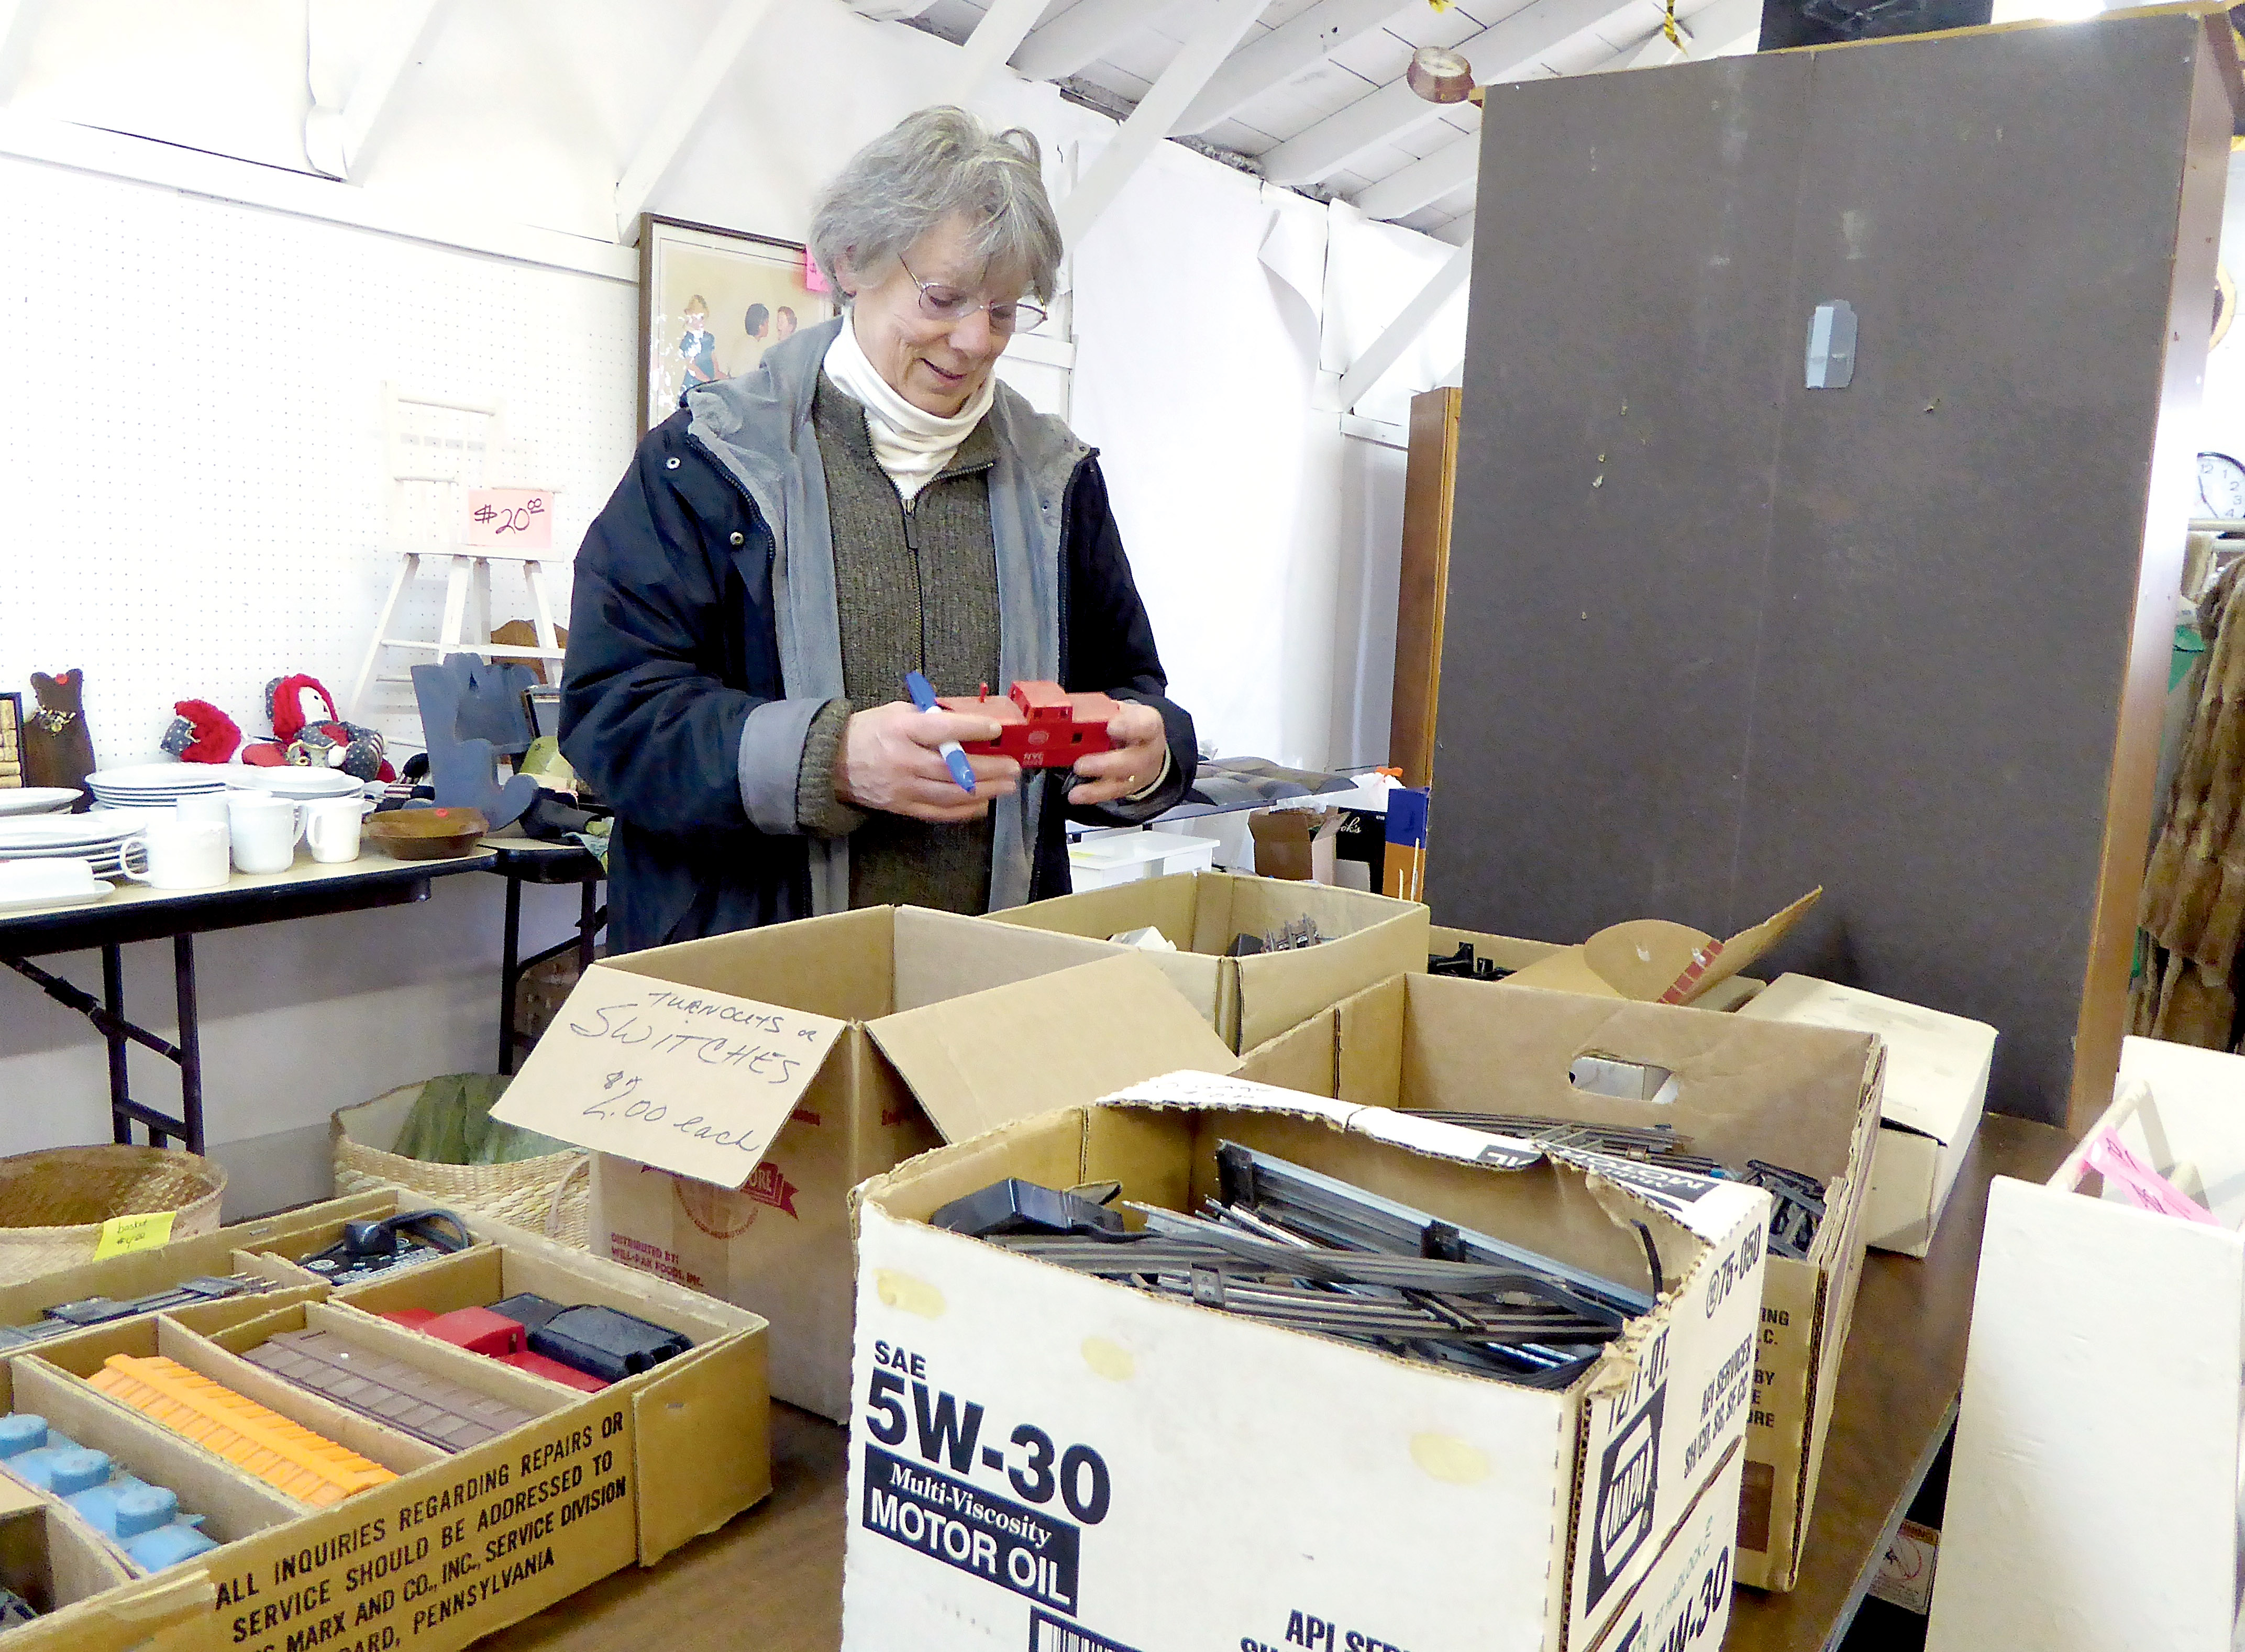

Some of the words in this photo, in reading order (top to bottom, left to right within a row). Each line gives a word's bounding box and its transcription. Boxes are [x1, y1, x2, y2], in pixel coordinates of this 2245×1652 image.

[2230, 481, 2239, 491] 2
[2233, 495, 2242, 505] 3
[570, 1004, 800, 1084] SWITCHES
[673, 1116, 760, 1151] each
[875, 1339, 926, 1380] SAE
[1761, 1307, 1789, 1326] ING
[865, 1366, 1111, 1525] 5W-30
[215, 1572, 260, 1611] ALL
[274, 1518, 385, 1585] INQUIRIES
[399, 1463, 510, 1532] REGARDING
[521, 1425, 593, 1477] REPAIRS
[601, 1411, 624, 1438] OR
[891, 1462, 1053, 1550] Multi-Viscosity
[1608, 1450, 1646, 1542] NAPA
[233, 1578, 331, 1644] SERVICE
[346, 1536, 429, 1592] SHOULD
[441, 1517, 465, 1549] BE
[477, 1465, 583, 1532] ADDRESSED
[592, 1449, 613, 1477] TO
[287, 1611, 346, 1652] MARX
[354, 1589, 395, 1627] AND
[485, 1511, 555, 1563] SERVICE
[560, 1476, 627, 1527] DIVISION
[871, 1487, 998, 1574] MOTOR
[1008, 1547, 1070, 1605] OIL
[413, 1546, 555, 1635] PENNSYLVANIA
[1285, 1609, 1336, 1652] API
